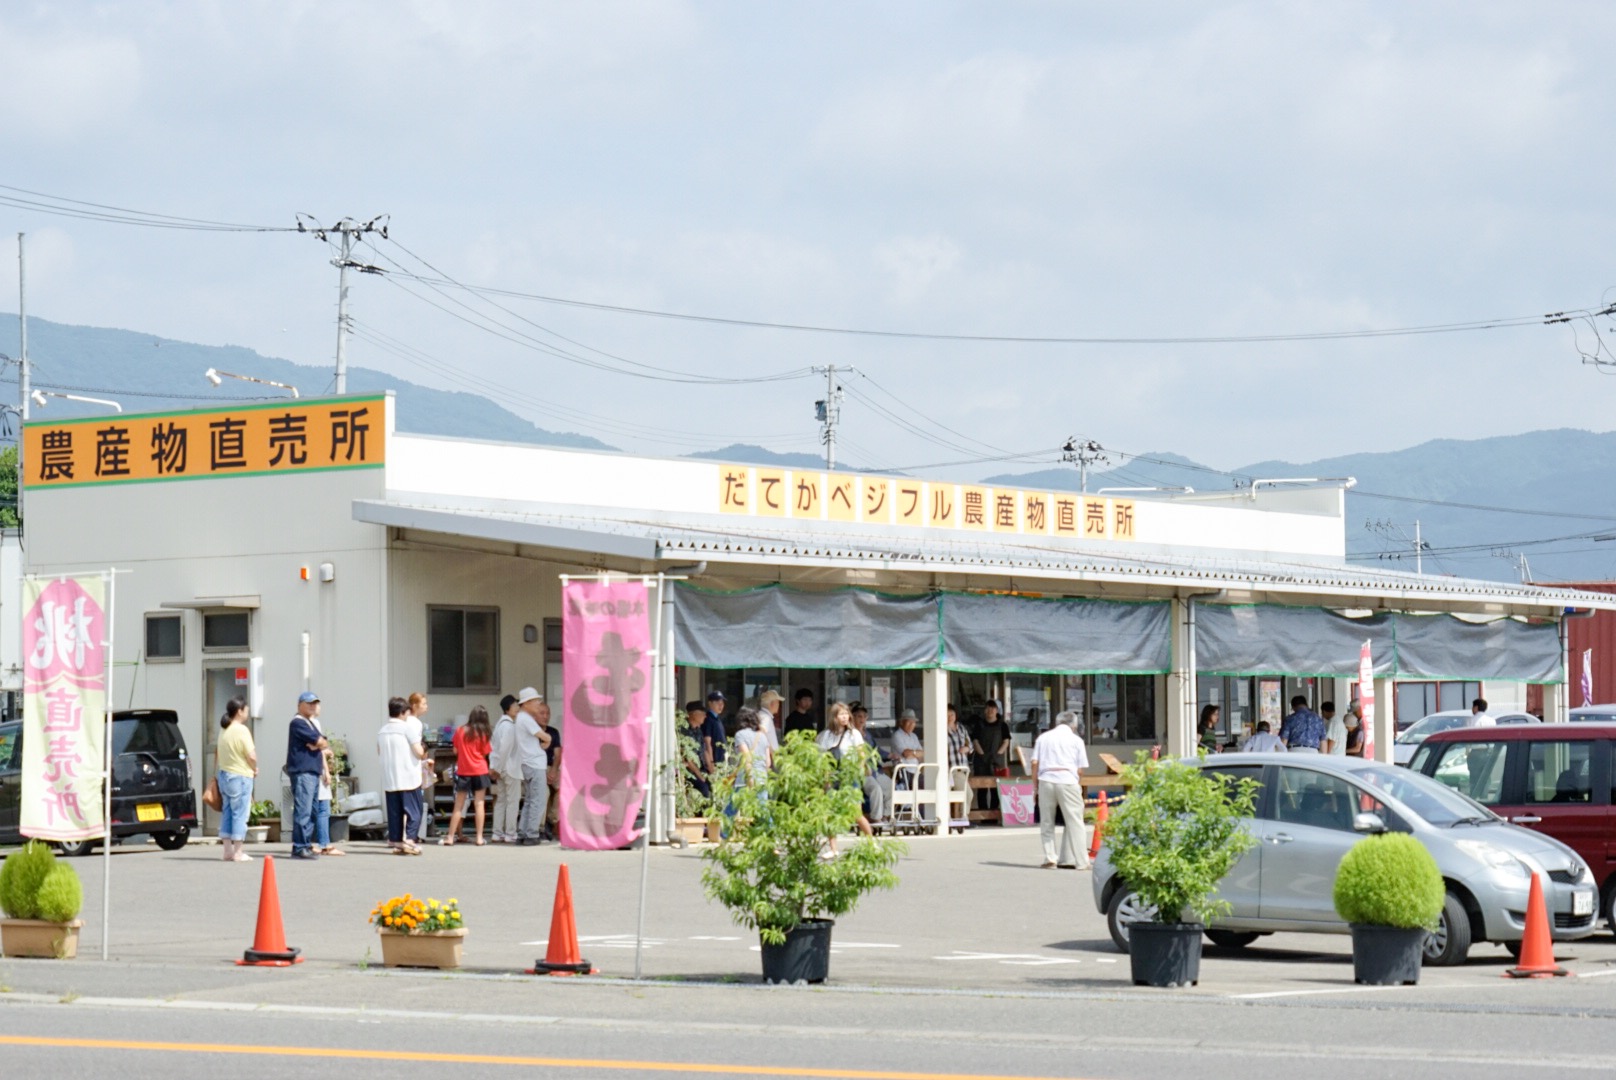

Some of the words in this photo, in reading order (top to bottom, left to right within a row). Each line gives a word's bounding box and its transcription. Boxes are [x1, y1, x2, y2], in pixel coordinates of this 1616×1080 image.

[39, 407, 370, 480] 農産物直売所
[724, 471, 1136, 535] だてかベジフル農産物直売所
